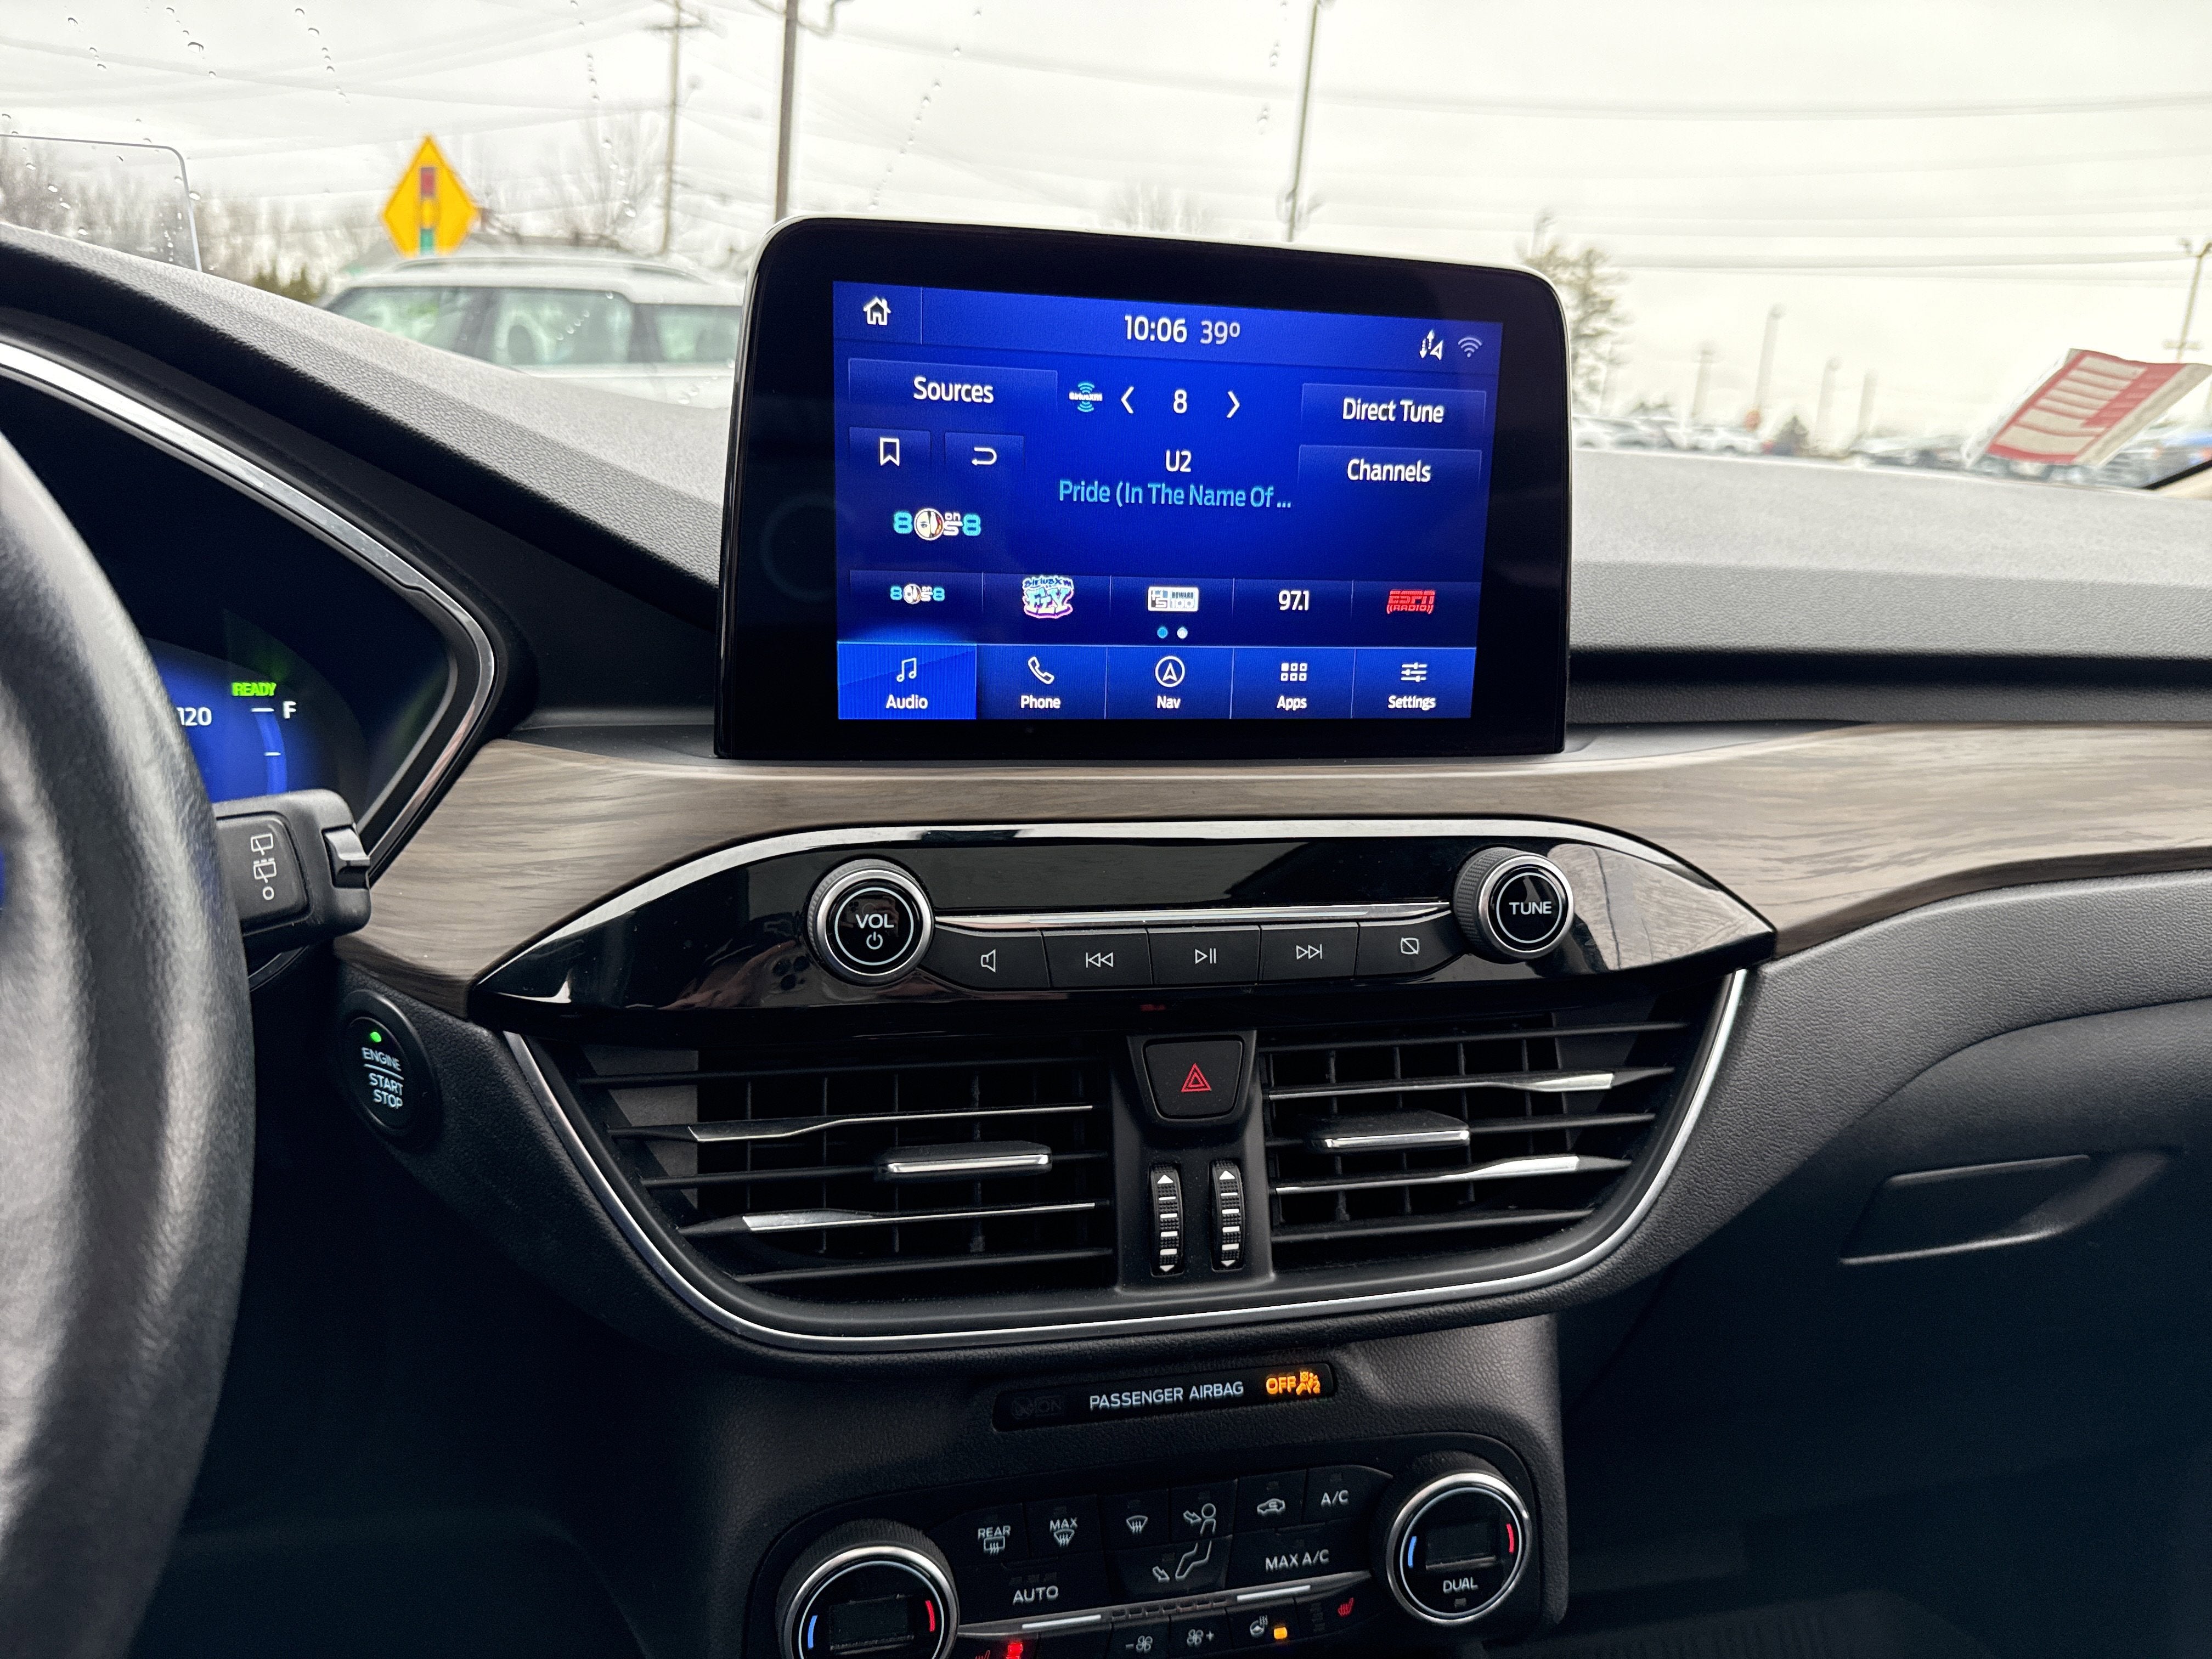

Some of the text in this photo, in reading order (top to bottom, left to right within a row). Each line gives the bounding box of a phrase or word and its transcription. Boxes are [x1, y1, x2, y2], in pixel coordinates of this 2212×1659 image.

[1124, 314, 1187, 343] 10:06
[913, 376, 994, 403] Sources
[1173, 389, 1187, 414] 8
[1342, 397, 1444, 423] Direct Tune
[1166, 450, 1192, 472] U2
[1347, 458, 1431, 482] Channels
[1059, 479, 1110, 503] Pride
[1116, 481, 1142, 507] (In
[1147, 482, 1184, 505] The
[1189, 483, 1246, 507] Name
[962, 514, 981, 536] 8
[1278, 589, 1310, 611] 97.1
[1387, 590, 1436, 605] ESPN
[232, 682, 276, 696] READY
[283, 701, 297, 719] F
[885, 693, 928, 709] Audio
[1020, 695, 1061, 709] Phone
[1156, 695, 1181, 709] Nav
[1276, 695, 1307, 711] Apps
[1387, 695, 1436, 711] Settings
[177, 707, 212, 726] 120
[1509, 901, 1552, 915] TUNE
[855, 913, 894, 929] VOL
[362, 1047, 402, 1071] ENGINE
[368, 1073, 404, 1096] START
[373, 1088, 403, 1109] STOP
[1090, 1381, 1244, 1409] PASSENGER AIRBAG
[1266, 1376, 1297, 1395] OFF
[1321, 1490, 1348, 1505] A/C
[978, 1525, 1011, 1538] REAR
[1049, 1518, 1077, 1531] MAX
[1265, 1549, 1329, 1570] MAX A/C
[1013, 1585, 1059, 1604] AUTO
[1443, 1577, 1478, 1593] DUAL
